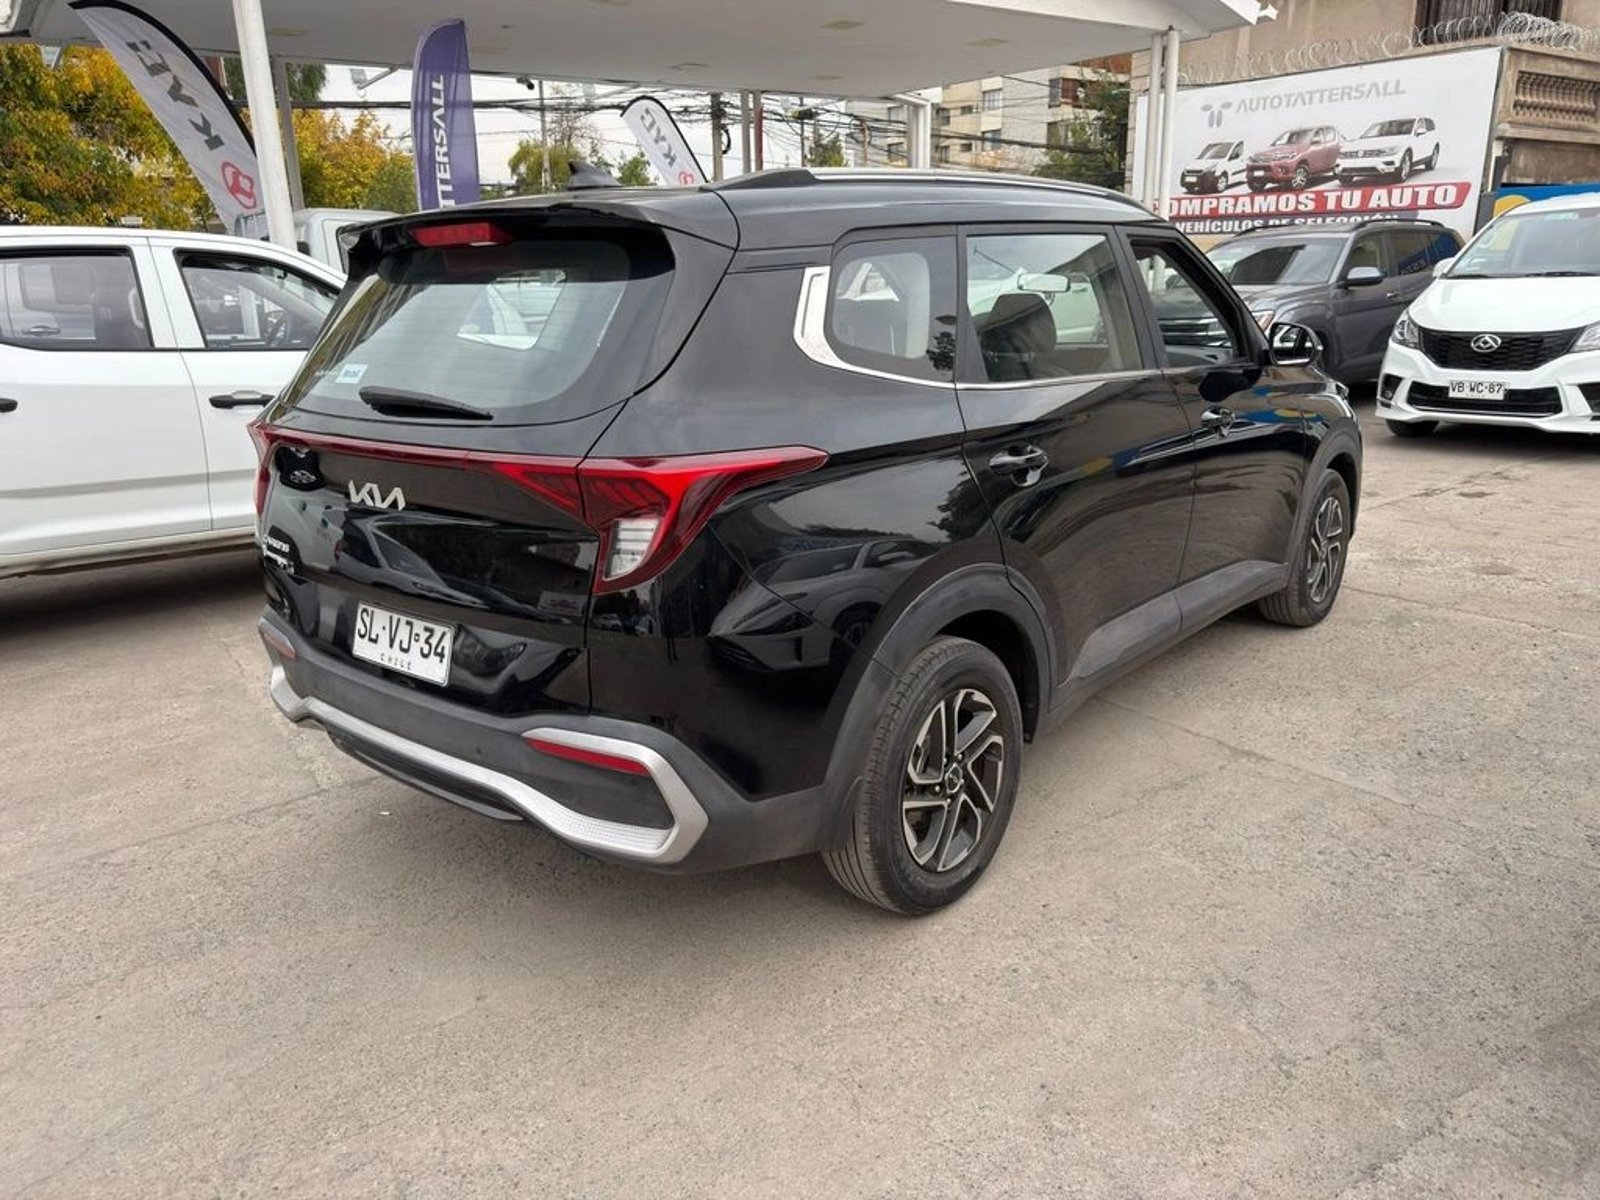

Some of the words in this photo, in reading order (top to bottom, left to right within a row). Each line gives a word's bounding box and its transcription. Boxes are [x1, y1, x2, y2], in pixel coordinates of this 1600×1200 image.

[1236, 79, 1406, 113] AUTOTATTERSALL
[1323, 188, 1362, 210] TU
[1368, 184, 1458, 209] AUTO
[348, 480, 406, 511] KIA
[381, 652, 412, 671] CHILE
